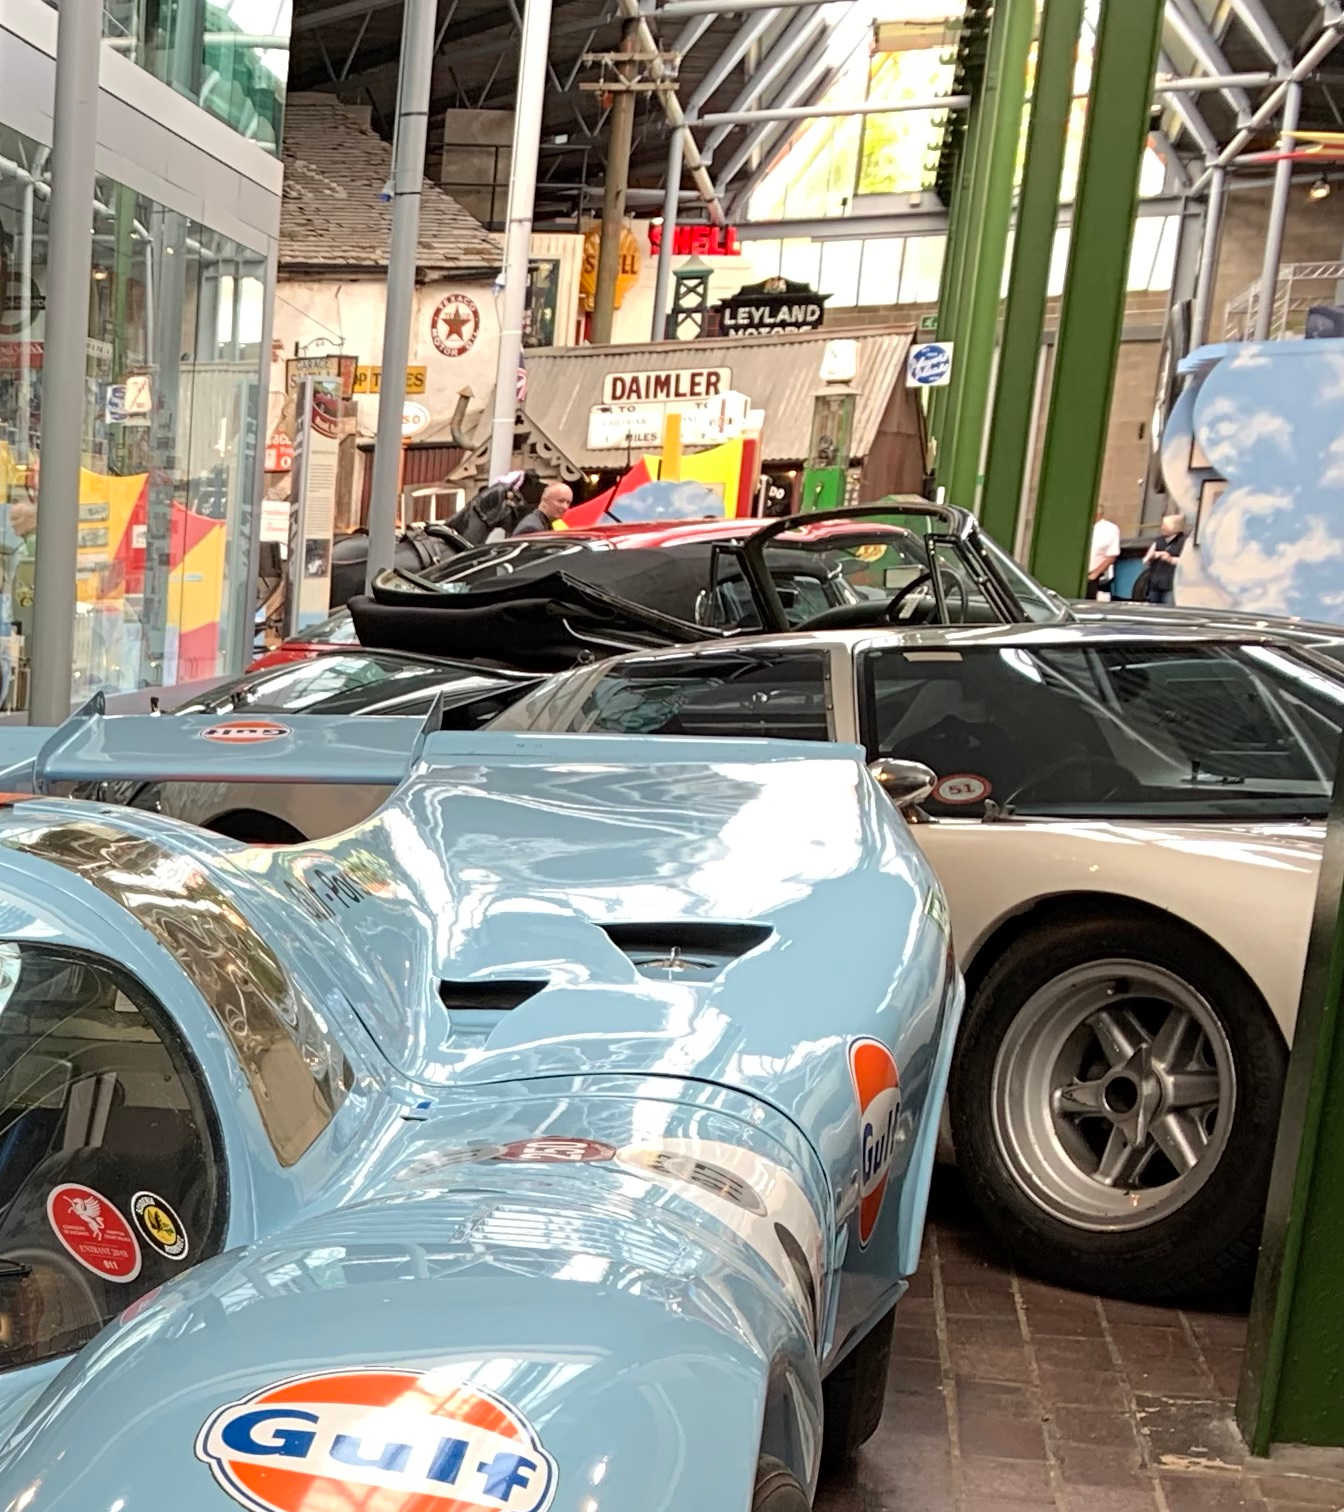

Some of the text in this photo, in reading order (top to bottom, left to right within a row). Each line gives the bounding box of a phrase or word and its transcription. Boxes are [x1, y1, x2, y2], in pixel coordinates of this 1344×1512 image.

[585, 254, 638, 275] SLL
[724, 304, 821, 325] LEYLAND
[370, 372, 424, 388] TES
[612, 371, 721, 400] DAIMLER
[949, 783, 975, 795] 51
[221, 1408, 538, 1503] Gulf
